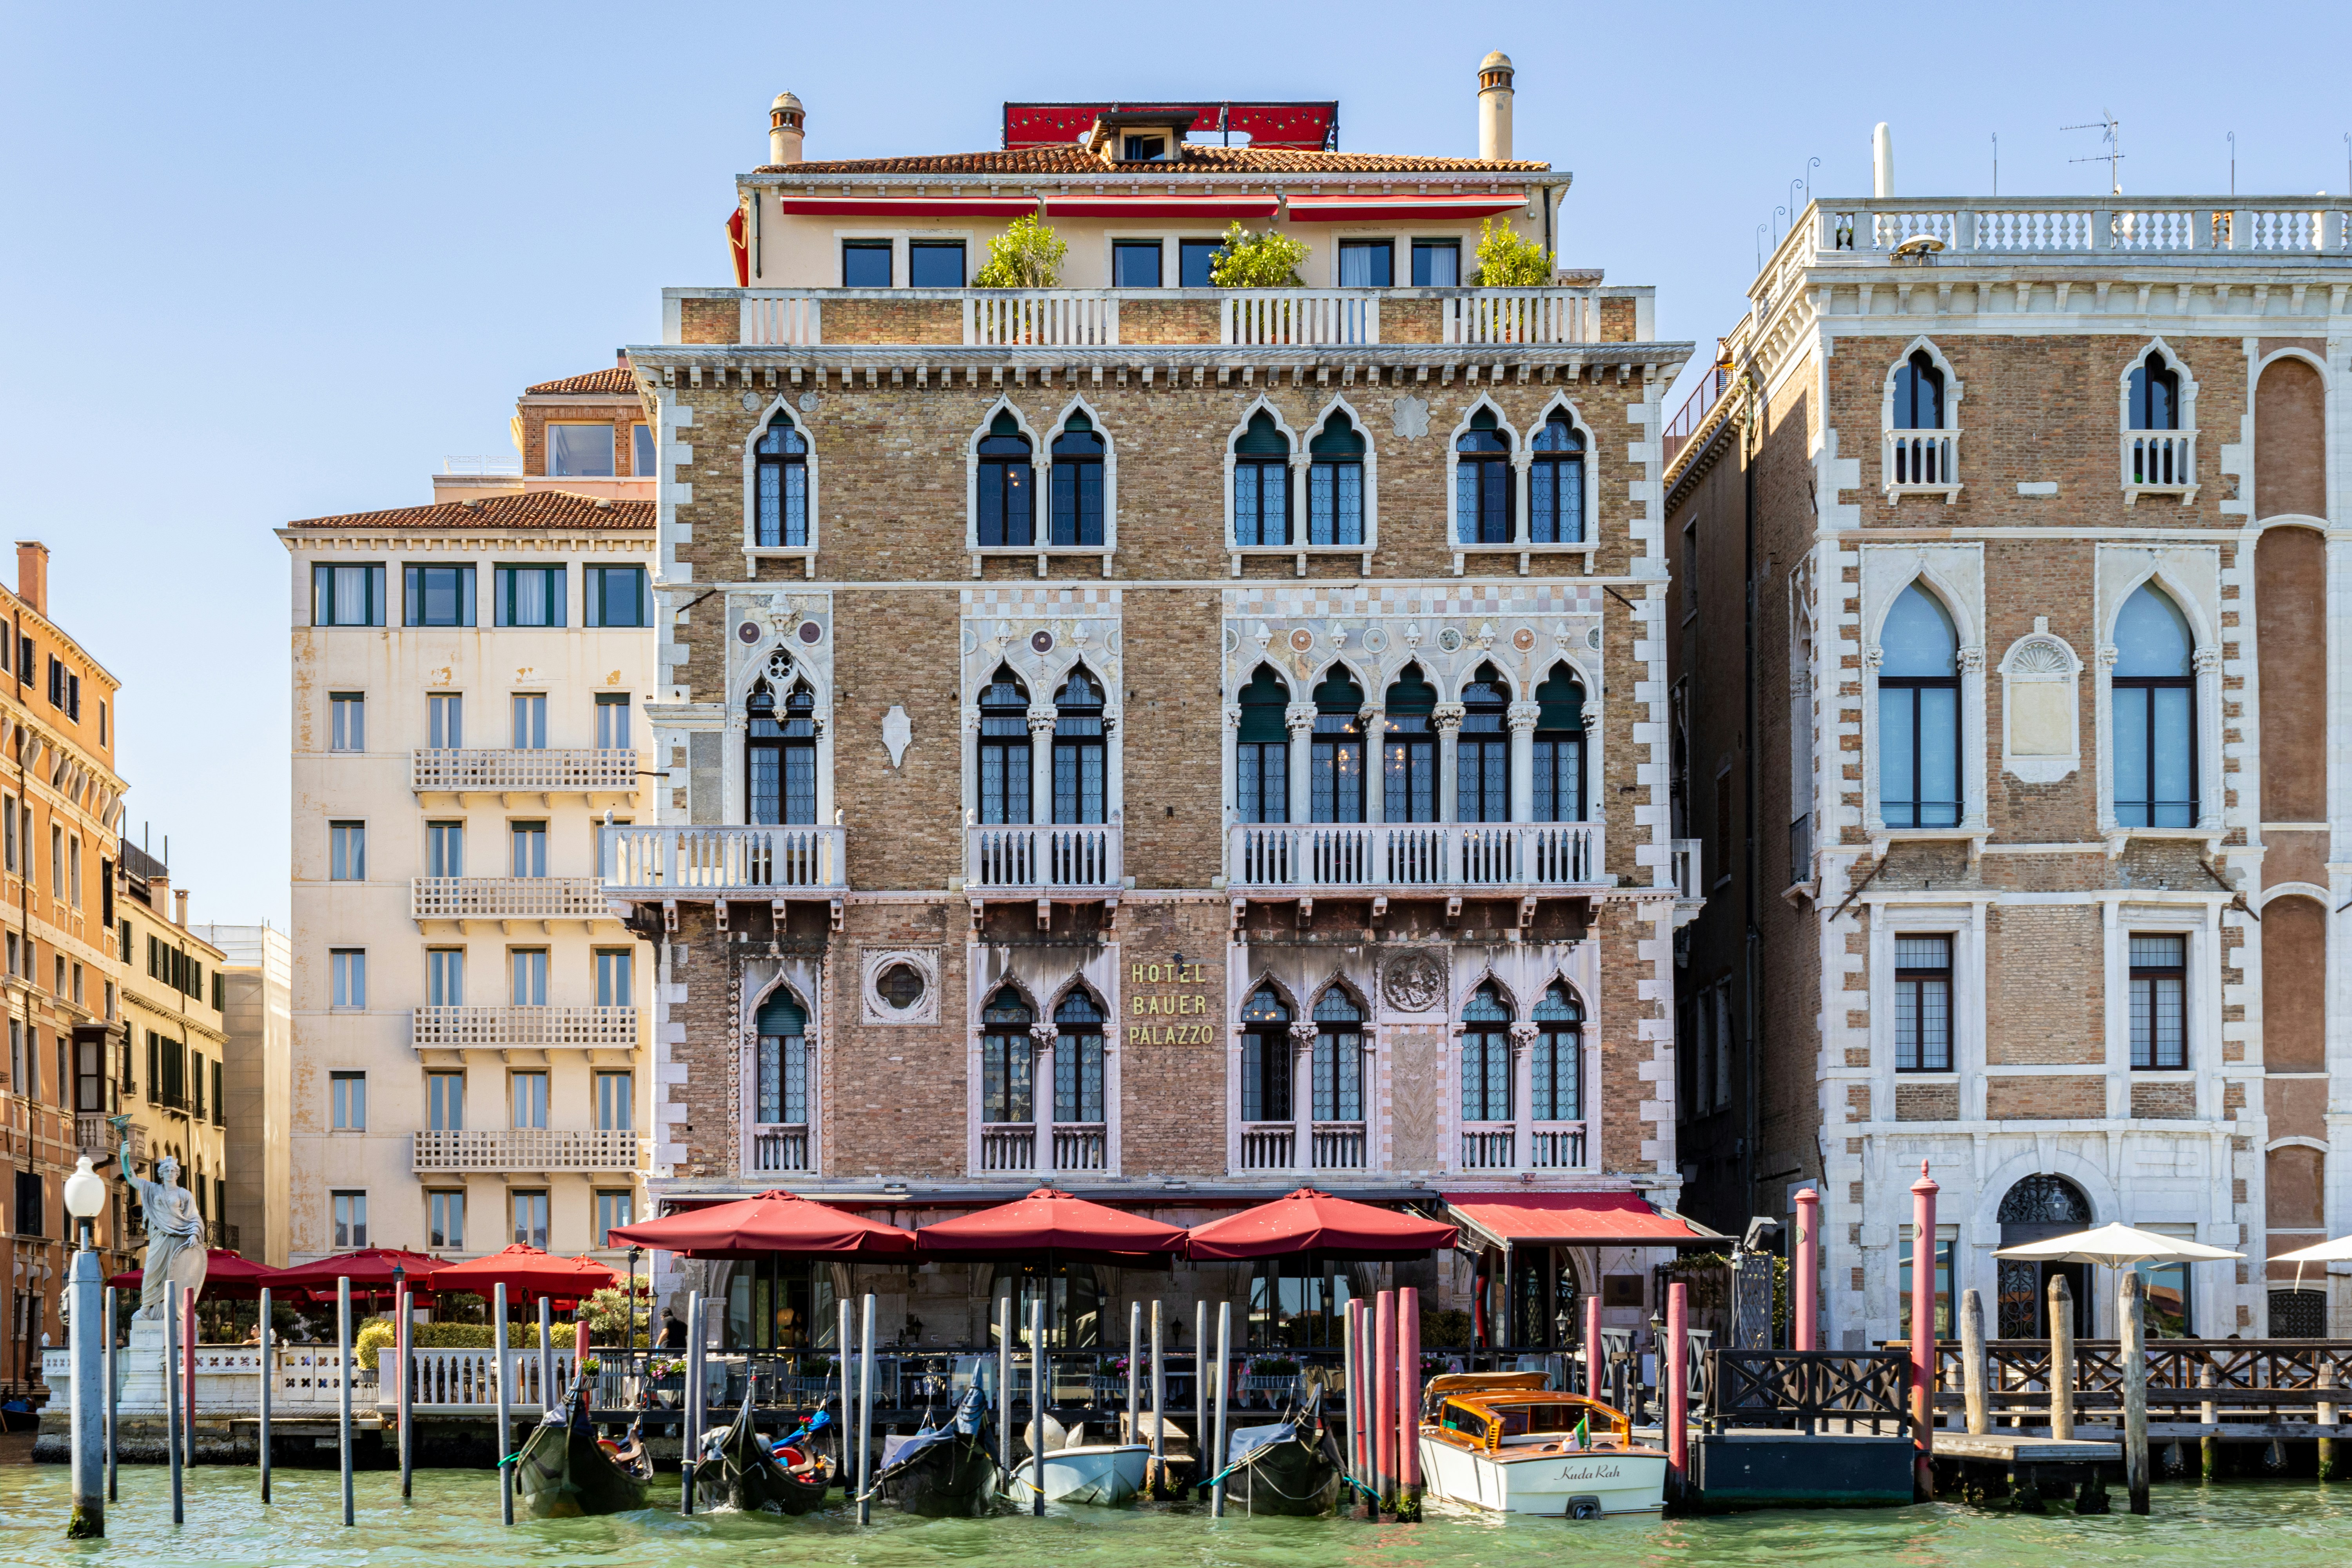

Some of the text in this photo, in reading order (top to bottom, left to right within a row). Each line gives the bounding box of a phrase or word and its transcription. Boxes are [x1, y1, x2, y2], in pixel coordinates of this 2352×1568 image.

[1132, 964, 1206, 983] HOTEL
[1133, 995, 1206, 1015] BAUER
[1129, 1025, 1213, 1045] PALAZZO
[1554, 1465, 1620, 1480] Kuda Rah
